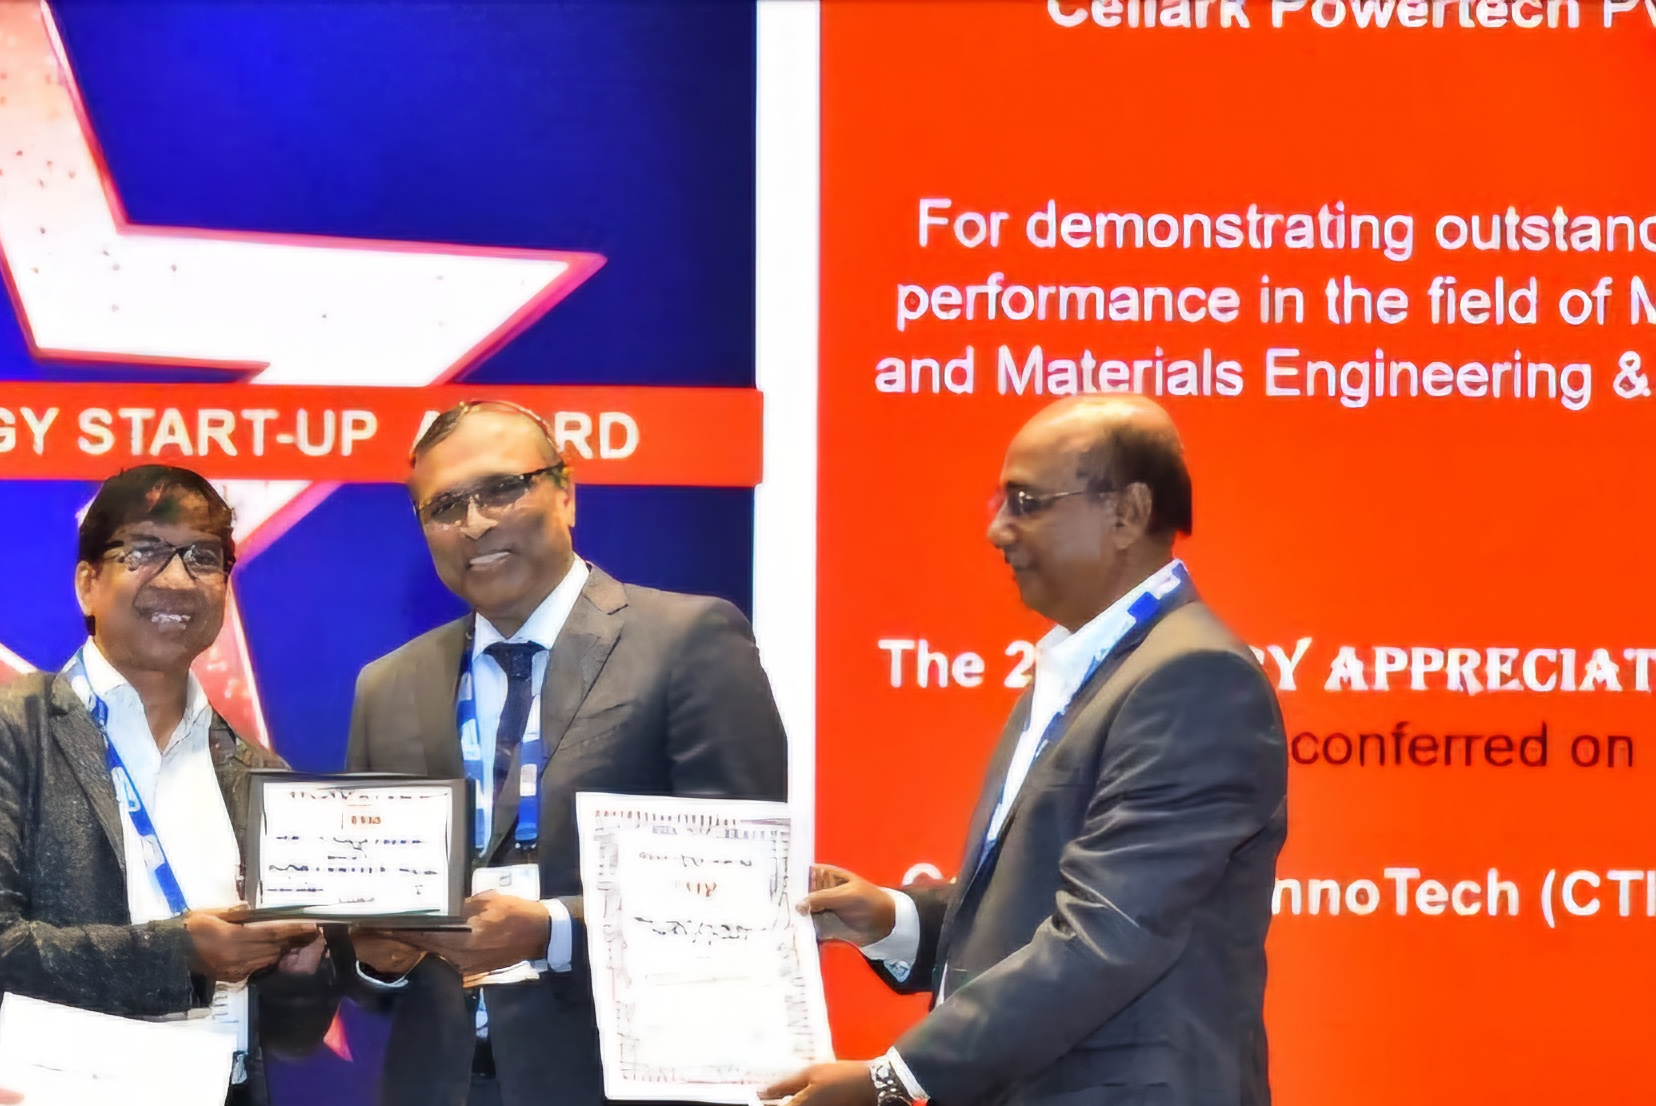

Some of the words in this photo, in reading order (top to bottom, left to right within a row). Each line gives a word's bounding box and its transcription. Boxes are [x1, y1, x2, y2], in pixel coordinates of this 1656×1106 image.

[1271, 0, 1580, 29] Powertech
[918, 198, 1010, 249] For
[1026, 200, 1414, 262] demonstrating
[896, 272, 1241, 332] performance
[1260, 274, 1304, 324] in
[1324, 274, 1409, 325] the
[1427, 275, 1538, 326] field
[1558, 276, 1613, 326] of
[874, 345, 975, 396] and
[997, 344, 1244, 397] Materials
[1265, 348, 1592, 411] Engineering
[1612, 350, 1652, 399] &
[77, 407, 377, 458] START-UP
[877, 638, 985, 689] The
[1323, 645, 1656, 696] APPRECIAT
[1290, 720, 1548, 768] conferred
[1570, 734, 1634, 768] on
[1271, 867, 1520, 917] nnoTech
